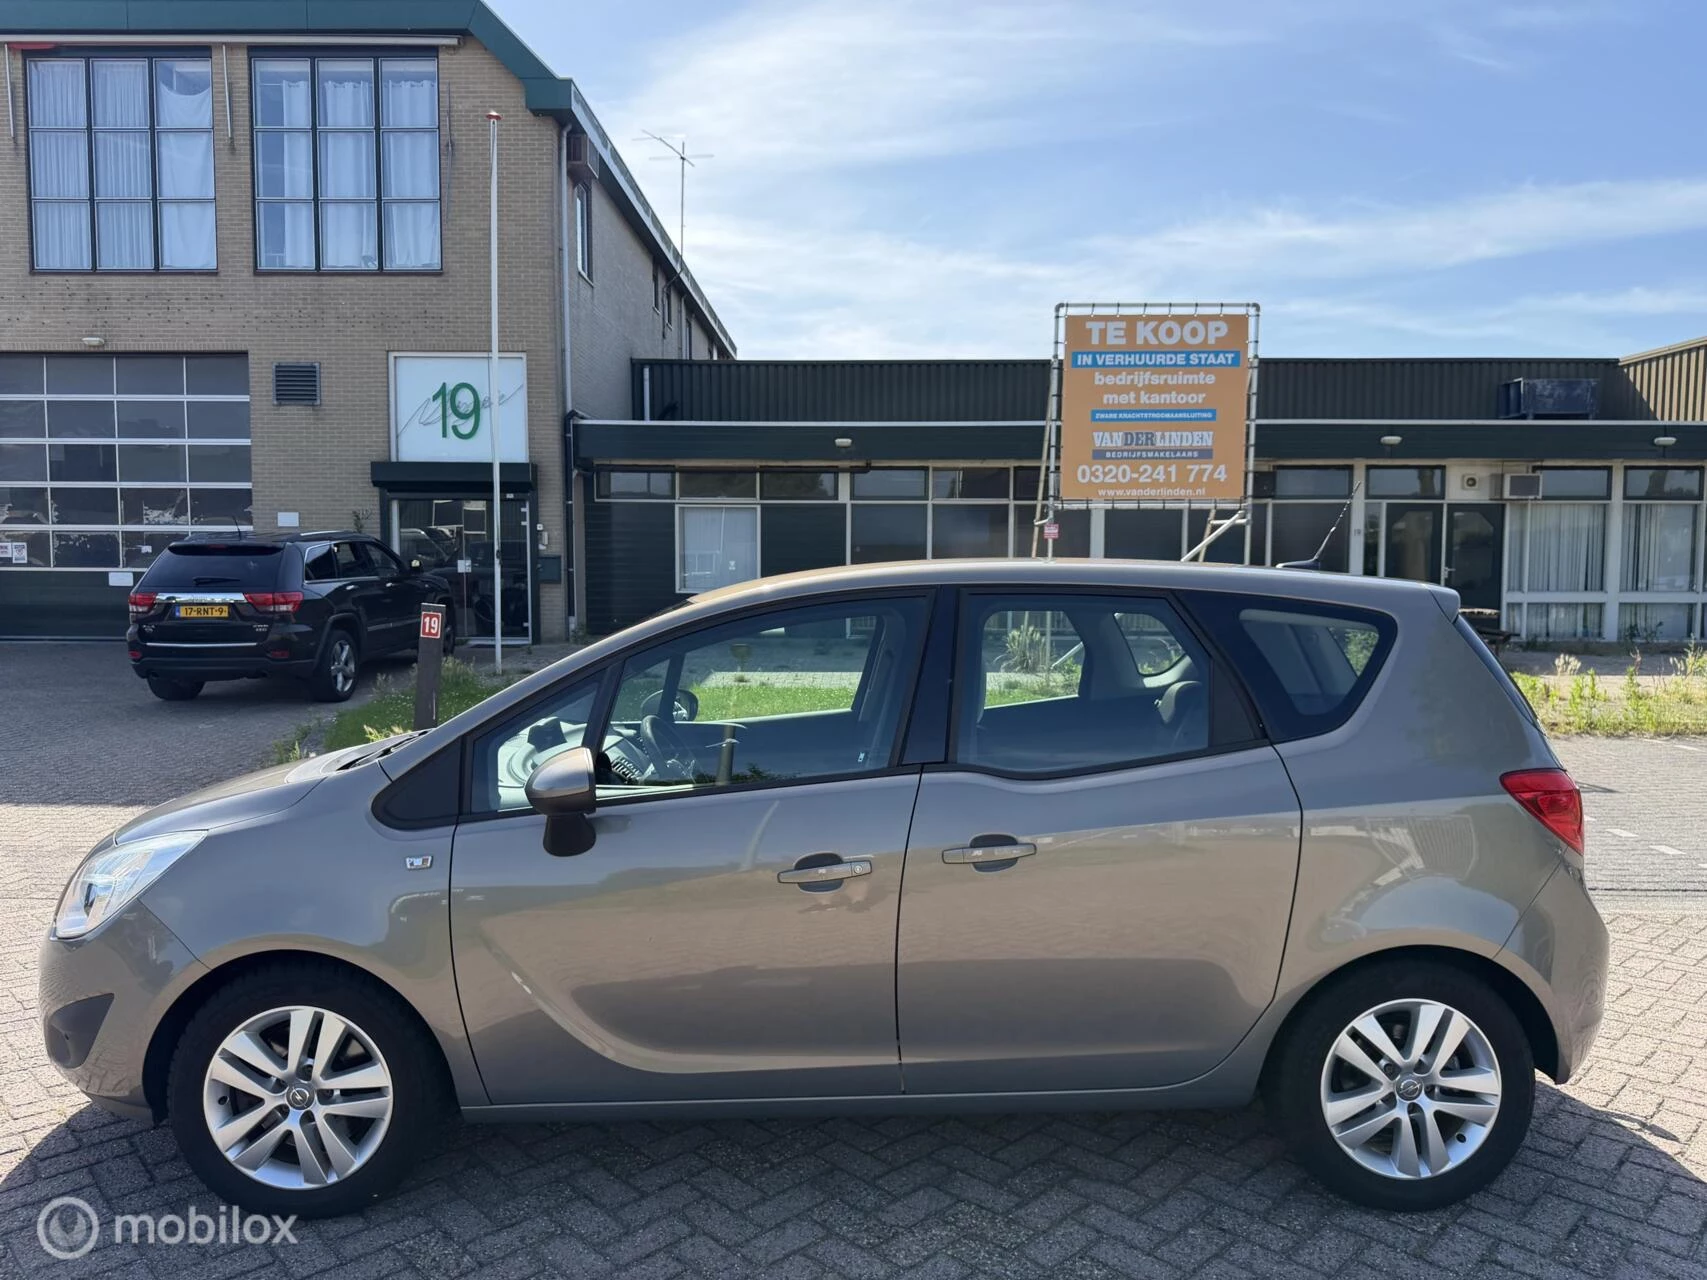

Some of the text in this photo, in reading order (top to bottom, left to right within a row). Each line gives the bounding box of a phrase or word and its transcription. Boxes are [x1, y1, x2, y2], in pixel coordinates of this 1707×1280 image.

[1086, 320, 1228, 345] TE KOOP
[1077, 353, 1235, 365] IN VERHUURDE STAAT
[1094, 371, 1216, 387] bedrijfsruimte
[1103, 391, 1206, 405] met kantoor
[432, 382, 481, 440] 19
[1077, 464, 1227, 483] 0320-241 774
[1098, 487, 1206, 497] www.vanderlinden.nl
[184, 607, 224, 616] 17-RNT-9
[424, 616, 439, 634] 19
